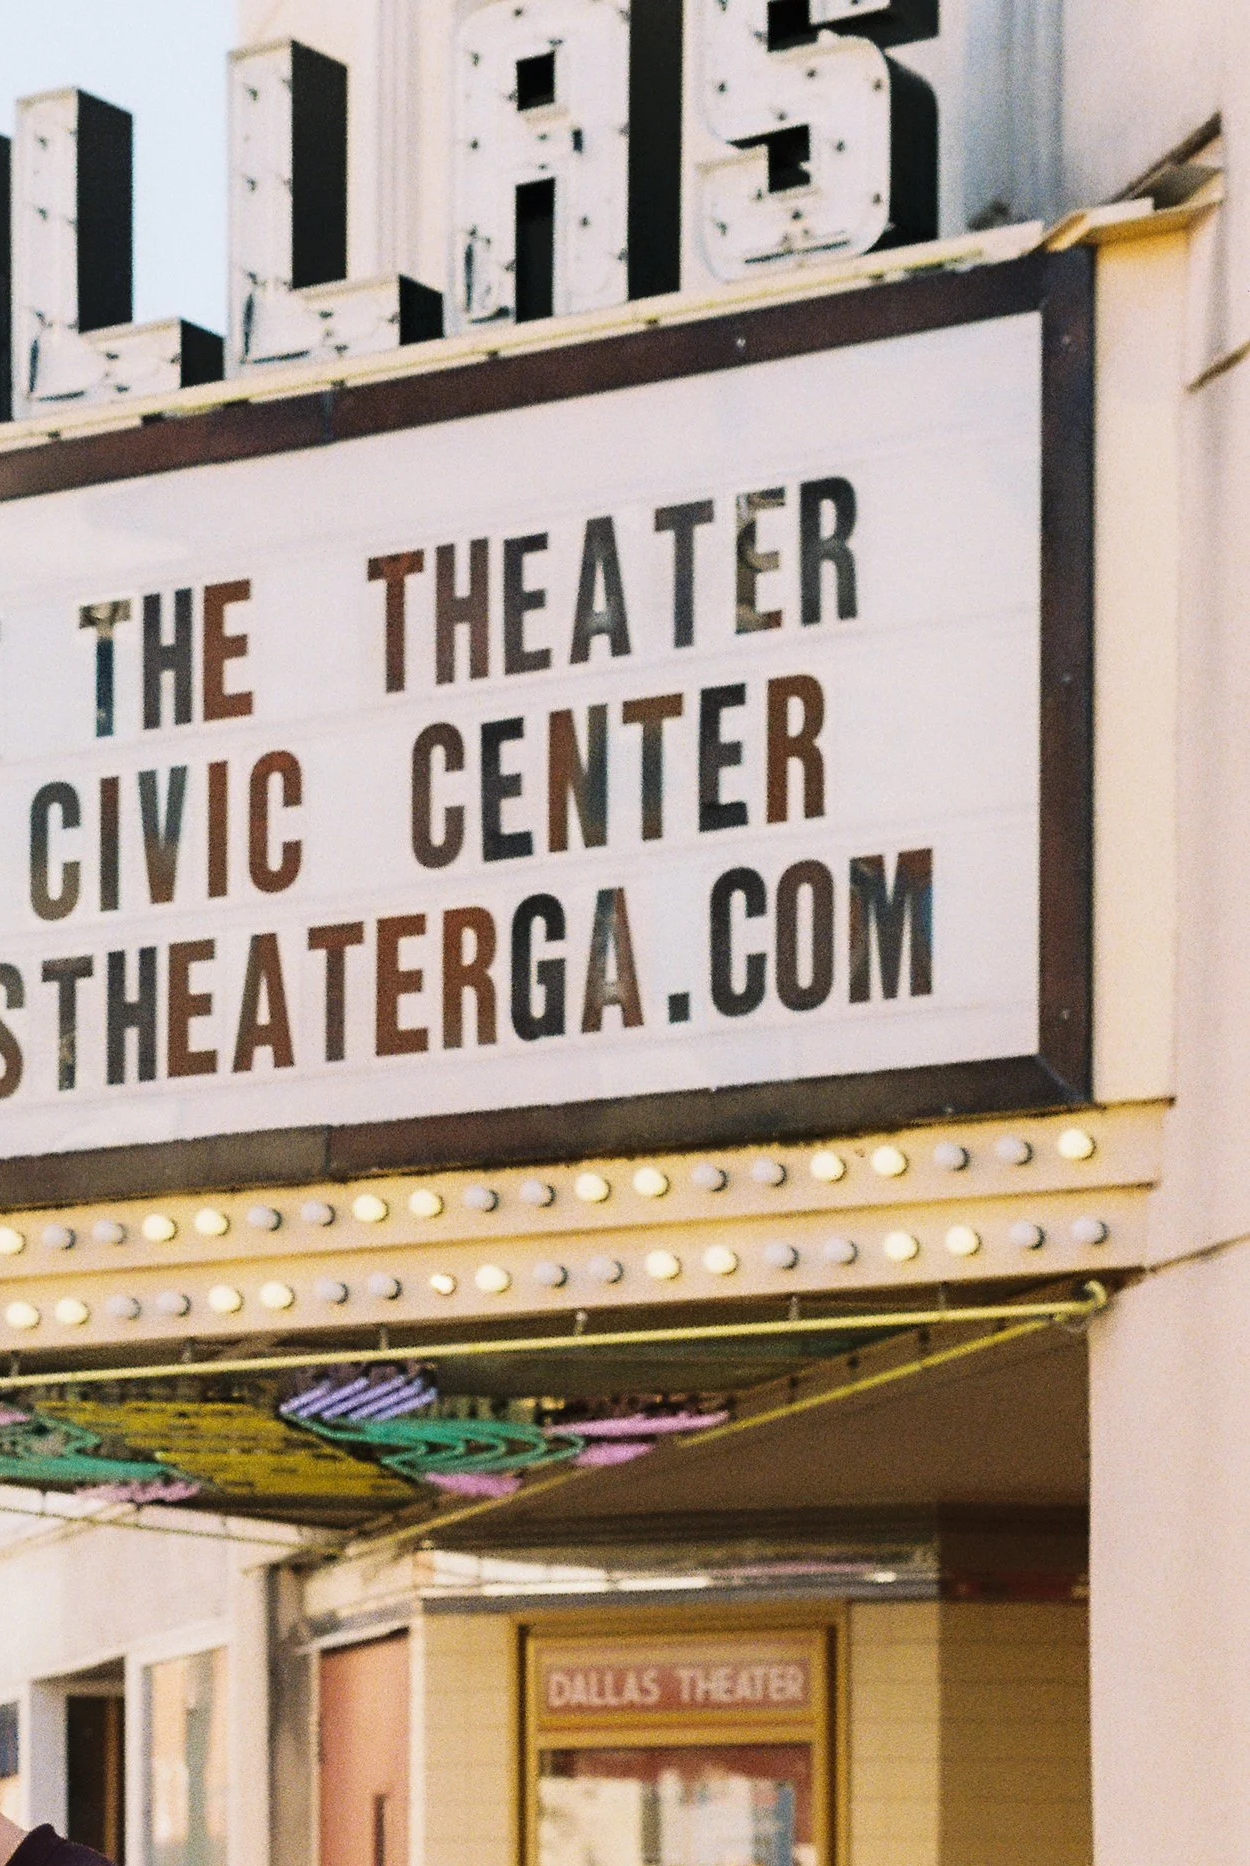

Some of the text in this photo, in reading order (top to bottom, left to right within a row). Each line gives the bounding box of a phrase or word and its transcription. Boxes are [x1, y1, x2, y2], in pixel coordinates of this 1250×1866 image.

[78, 578, 254, 738] THE
[366, 475, 858, 694] THEATER
[28, 749, 303, 922] CIVIC
[410, 673, 826, 870] CENTER
[548, 1663, 805, 1707] DALLAS THEATER
